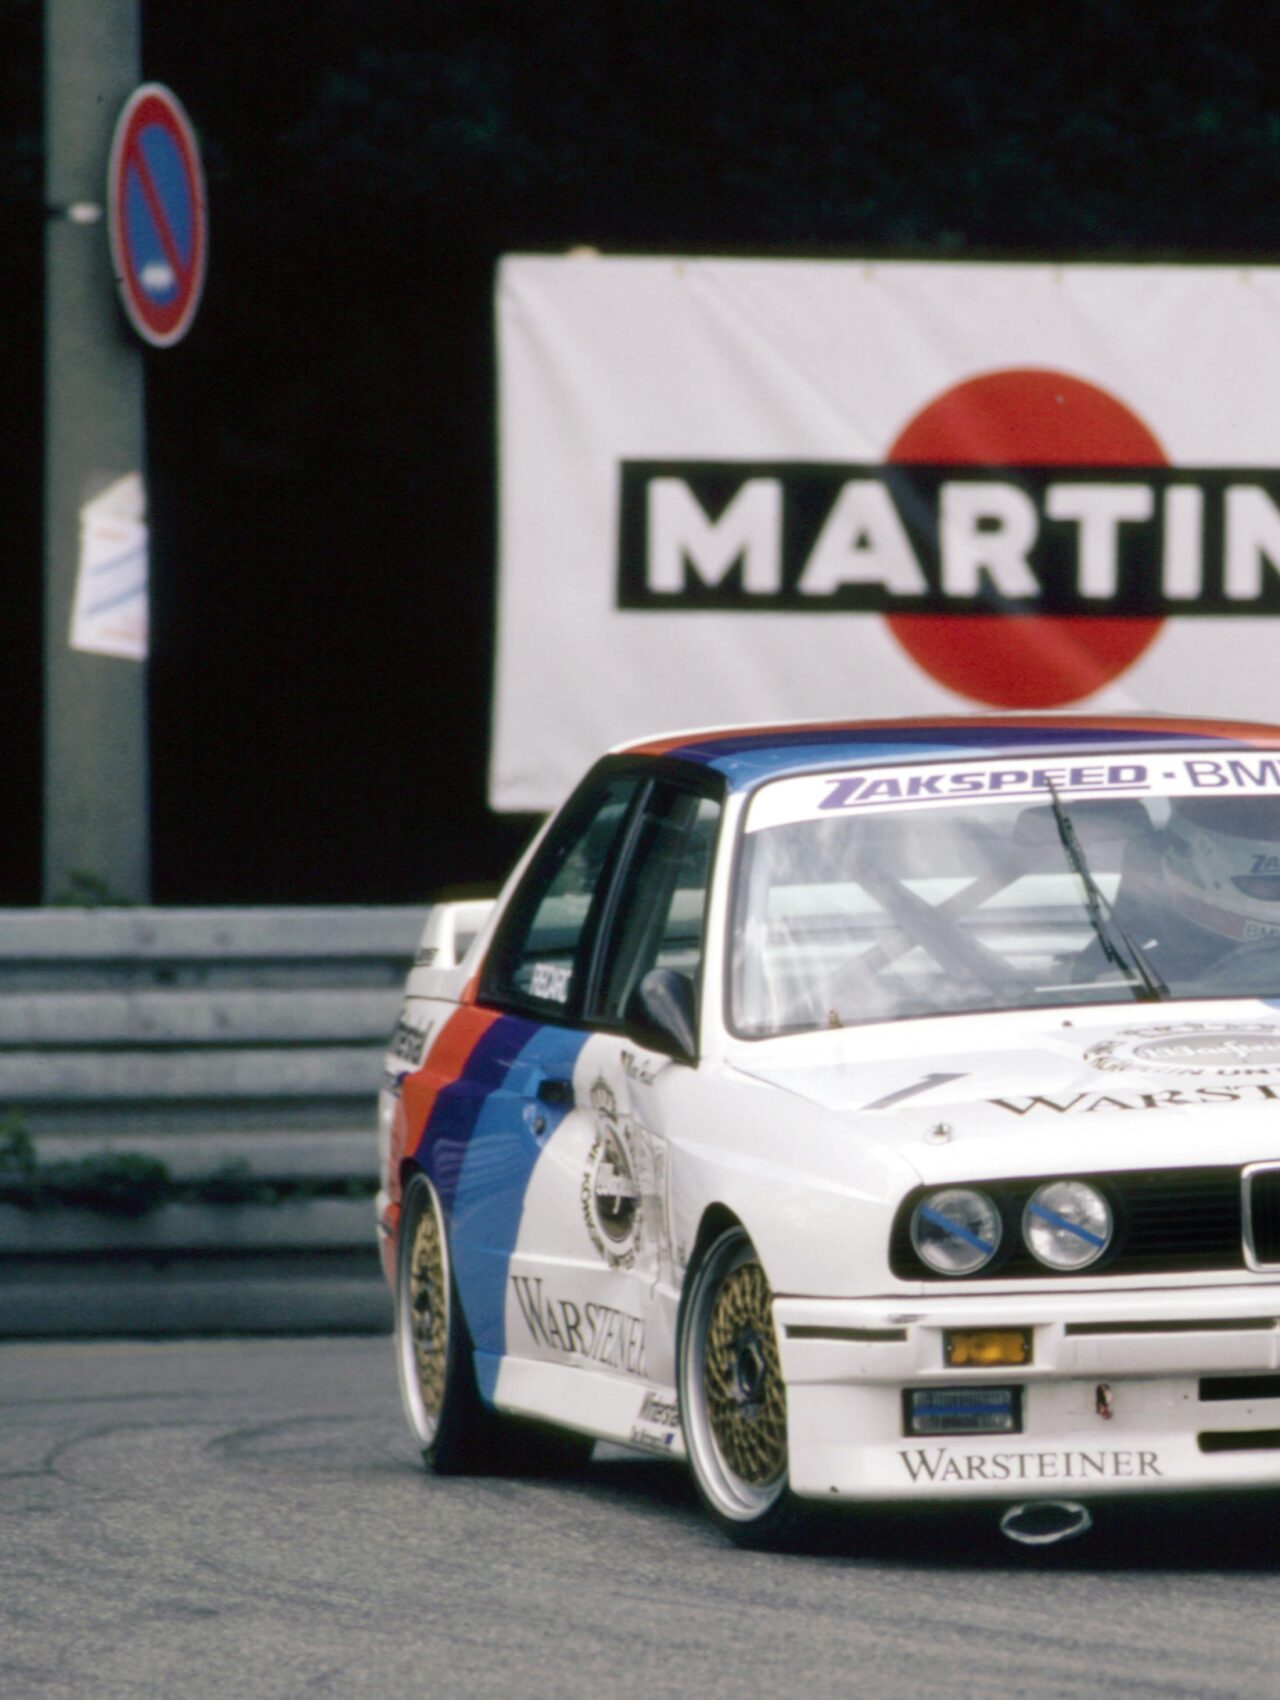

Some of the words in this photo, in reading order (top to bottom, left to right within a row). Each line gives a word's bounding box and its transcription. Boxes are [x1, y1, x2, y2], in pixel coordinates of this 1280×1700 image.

[817, 764, 1151, 811] ZAKSPEED
[858, 1072, 972, 1111] 1
[897, 1447, 1164, 1483] WARSTEINER
